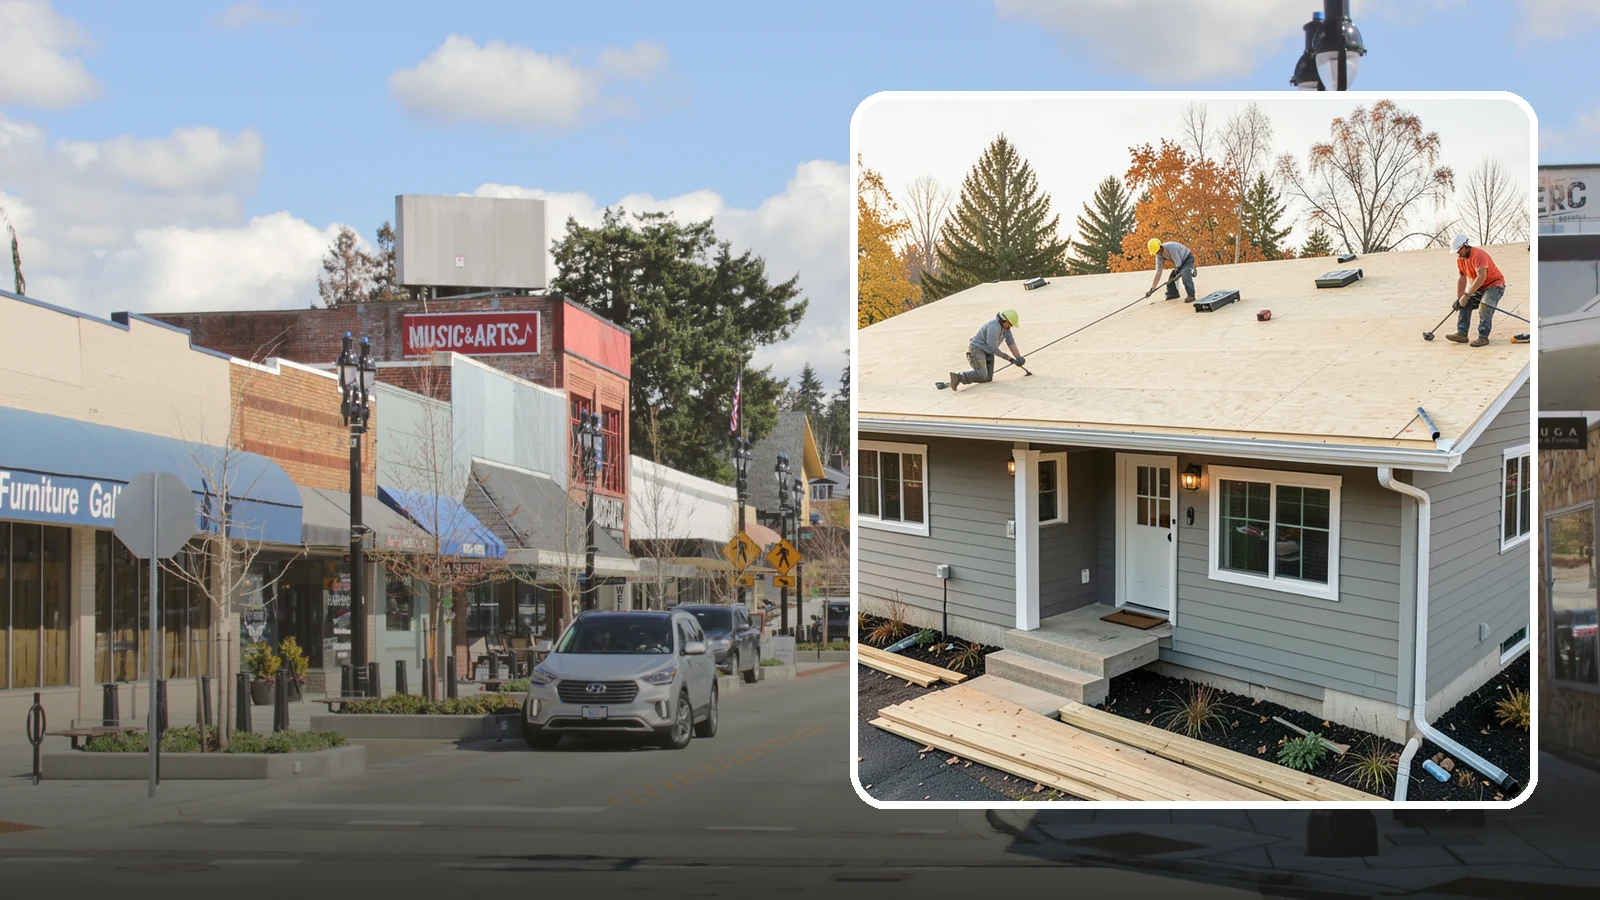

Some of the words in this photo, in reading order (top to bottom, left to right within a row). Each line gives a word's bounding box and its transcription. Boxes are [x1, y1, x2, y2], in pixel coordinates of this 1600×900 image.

[409, 323, 519, 349] MUSIC&ARTS
[1540, 427, 1577, 436] UGA
[0, 471, 79, 515] Furniture
[89, 482, 121, 519] Gal
[453, 563, 479, 574] SUSHI
